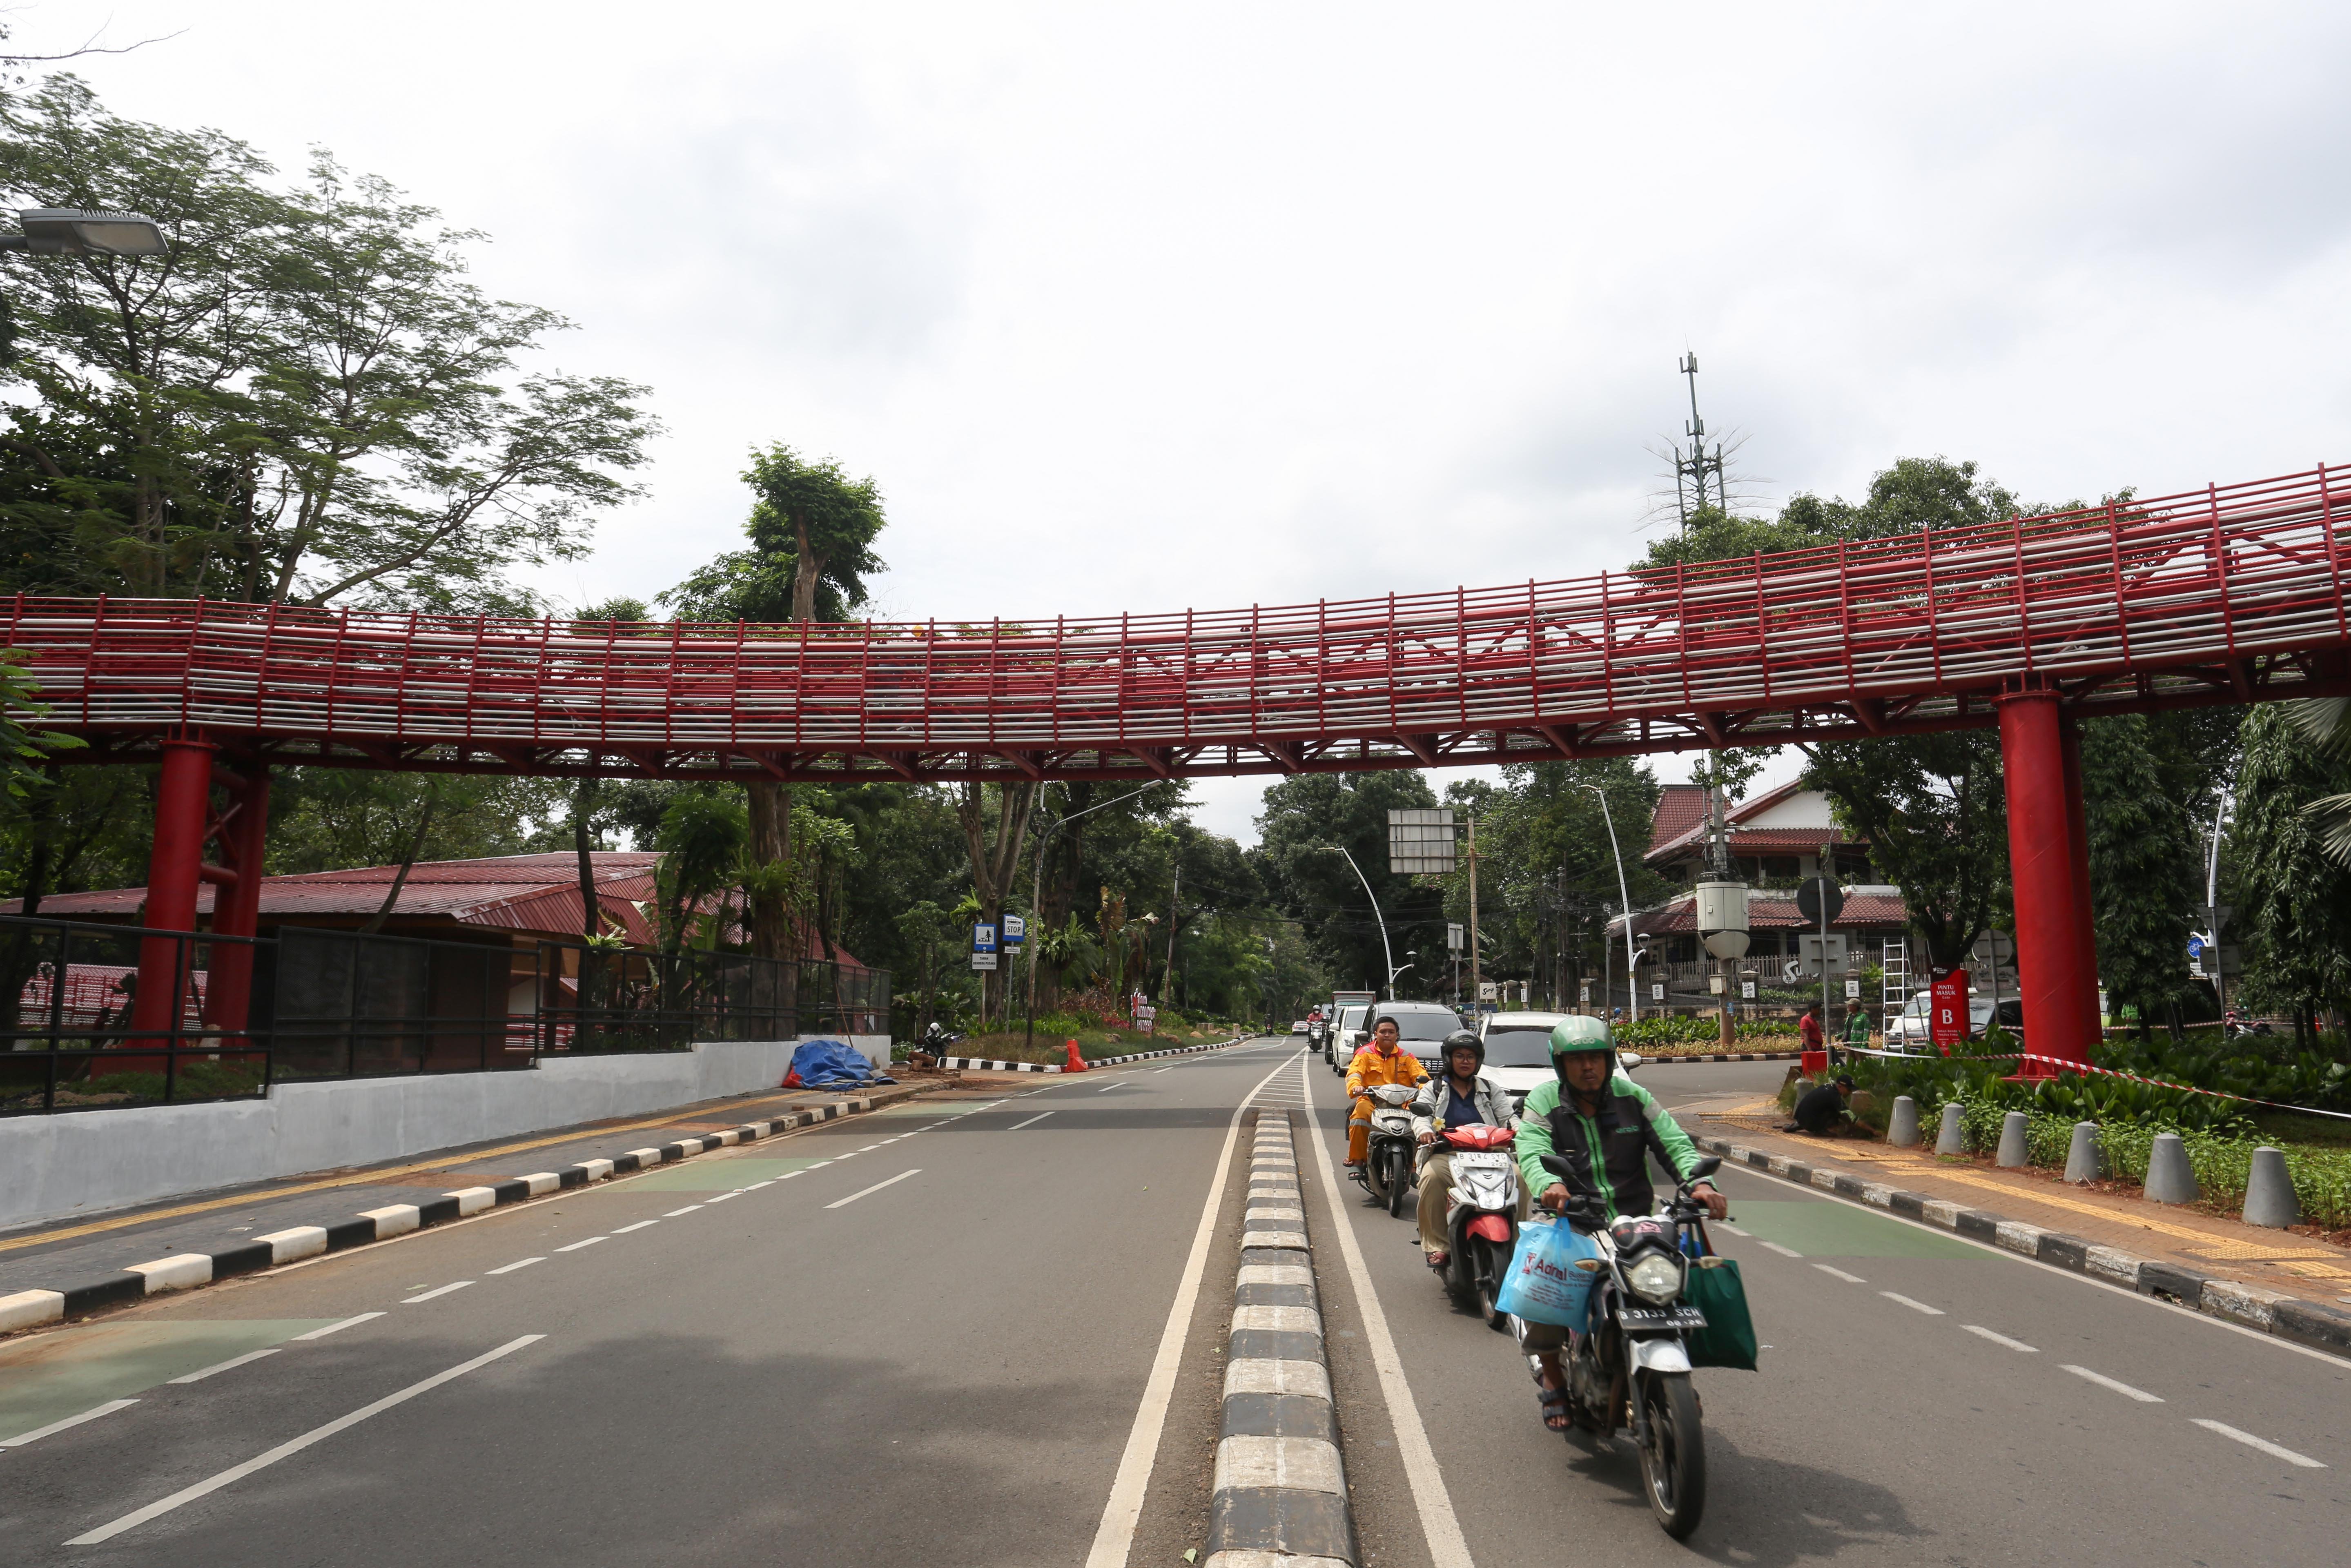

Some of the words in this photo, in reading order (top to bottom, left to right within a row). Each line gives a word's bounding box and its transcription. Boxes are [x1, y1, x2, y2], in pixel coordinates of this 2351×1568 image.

[1942, 1009, 1953, 1024] B
[1618, 1310, 1629, 1320] B
[1633, 1309, 1667, 1319] 3133
